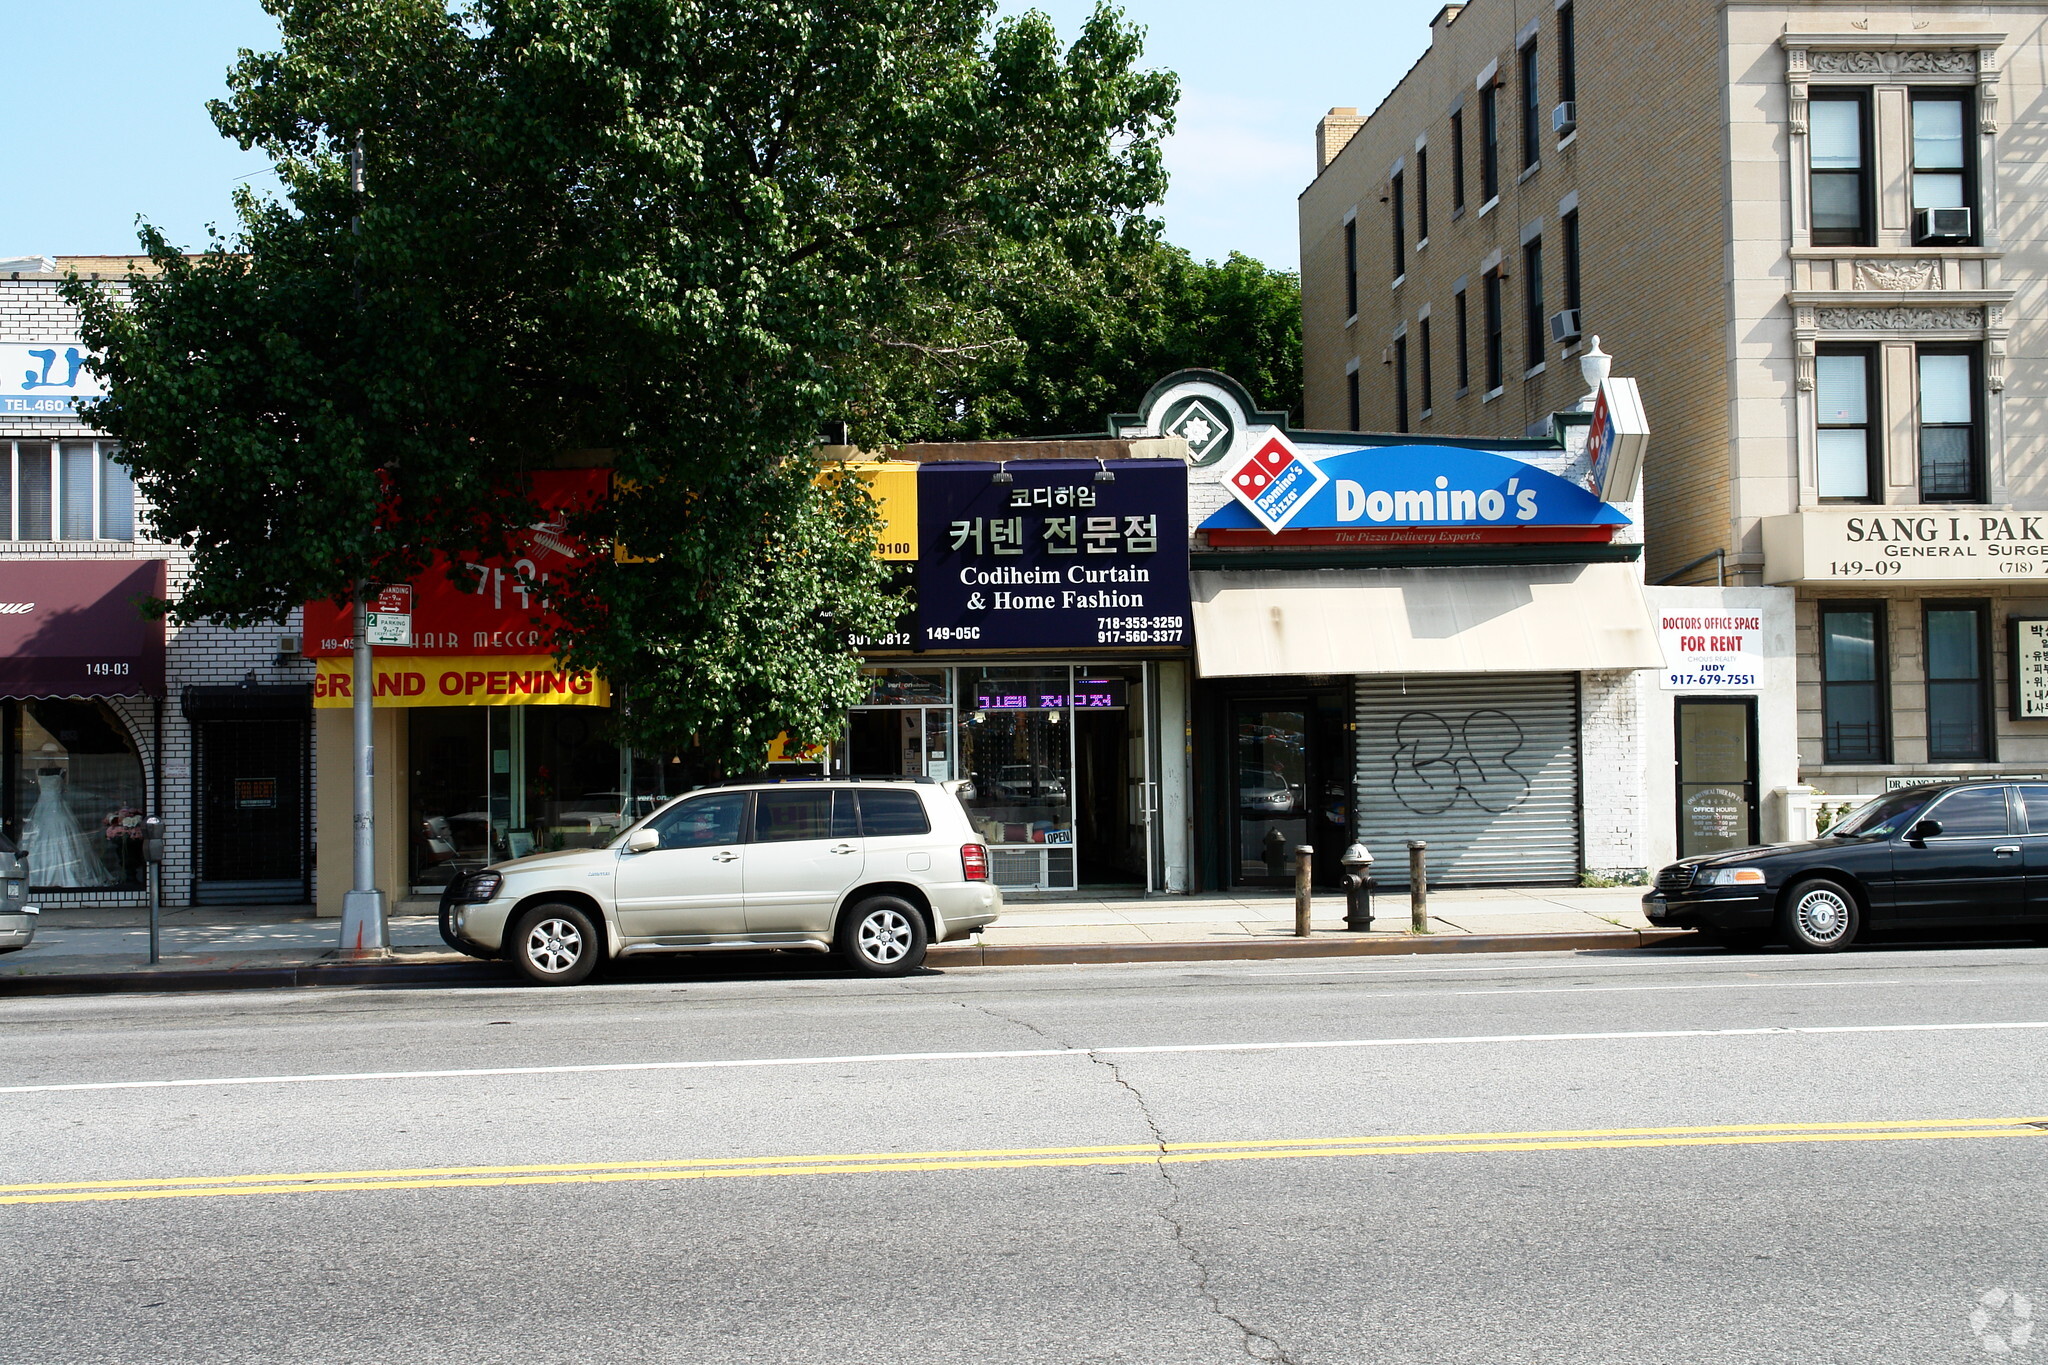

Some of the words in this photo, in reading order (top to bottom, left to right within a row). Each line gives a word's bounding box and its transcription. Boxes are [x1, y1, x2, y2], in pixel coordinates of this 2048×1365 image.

[1257, 465, 1303, 511] Domino's
[1010, 486, 1096, 508] 코디하임
[1335, 475, 1538, 522] Domino's
[949, 516, 1024, 555] 커텐
[1042, 514, 1157, 554] 전문점
[1846, 517, 1938, 541] SANG
[1948, 517, 1969, 541] I.
[1979, 517, 2044, 541] PAK
[1335, 532, 1355, 542] The
[1357, 532, 1388, 542] Pizza
[1390, 531, 1436, 543] Delivery
[1439, 531, 1482, 541] Experts
[1884, 545, 1977, 557] GENERAL
[960, 566, 1061, 585] Codiheim
[1067, 564, 1150, 584] Curtain
[1830, 560, 1902, 576] 149-09
[1999, 561, 2033, 574] (718)
[967, 592, 986, 610] &
[993, 591, 1055, 610] Home
[1061, 589, 1144, 609] Fashion
[368, 614, 376, 626] 2
[1097, 616, 1183, 629] 718-353-3250
[1662, 617, 1701, 630] DOCTORS
[1704, 617, 1732, 630] OFFICE
[1734, 617, 1760, 630] SPACE
[409, 632, 458, 648] HAIR
[926, 626, 980, 640] 149-05C
[1097, 630, 1183, 643] 917-560-3377
[1680, 636, 1706, 652] FOR
[1710, 636, 1743, 652] RENT
[86, 663, 129, 675] 149-03
[1700, 664, 1726, 672] JUDY
[439, 670, 593, 695] OPENING
[1670, 674, 1755, 685] 917-679-7551
[1048, 831, 1070, 844] OPEN
